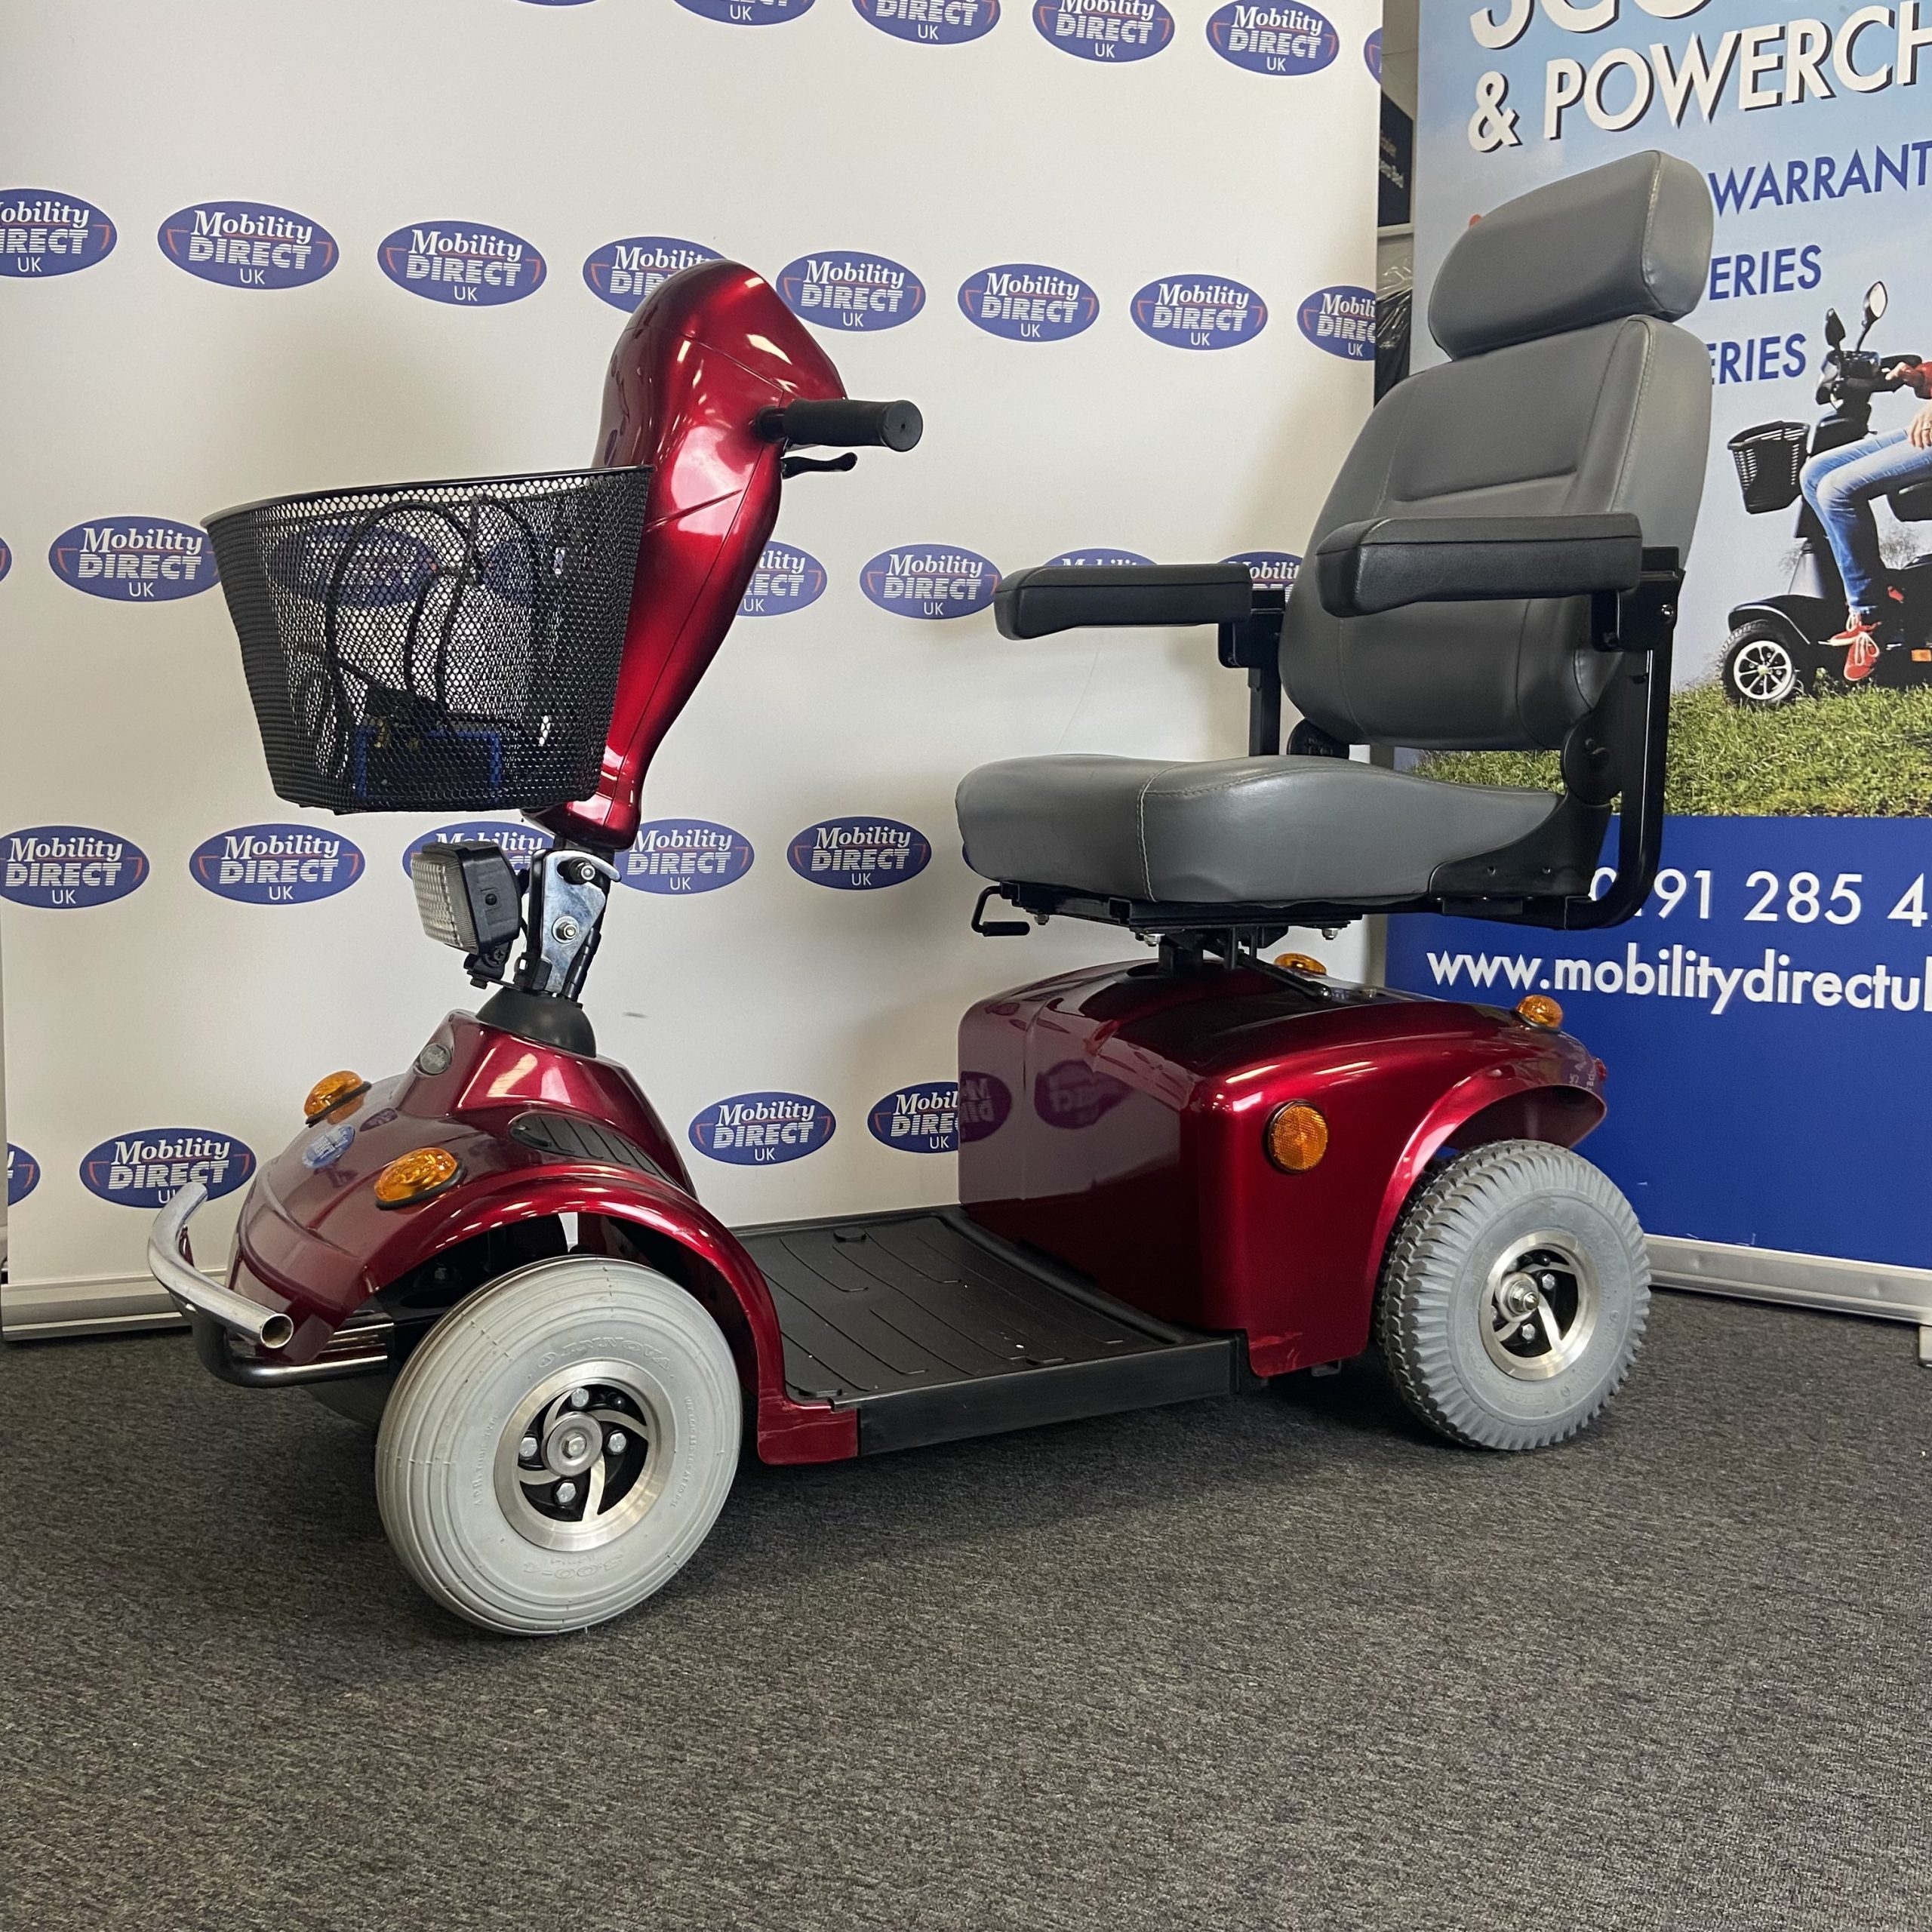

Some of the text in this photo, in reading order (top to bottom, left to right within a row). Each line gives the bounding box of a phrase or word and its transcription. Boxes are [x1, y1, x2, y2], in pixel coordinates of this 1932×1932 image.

[730, 5, 752, 21] UK
[876, 0, 978, 26] DIRECT
[1231, 5, 1322, 36] Mobility
[918, 25, 939, 39] UK
[1056, 14, 1152, 45] DIRECT
[1095, 43, 1115, 58] UK
[1229, 29, 1321, 58] DIRECT
[1266, 57, 1285, 72] UK
[1468, 71, 1521, 152] &
[0, 201, 89, 228] obility
[192, 211, 312, 243] Mobility
[189, 237, 312, 269] DIRECT
[411, 229, 521, 261] Mobility
[17, 256, 42, 272] UK
[612, 246, 714, 270] Mobilit
[240, 268, 265, 285] UK
[407, 255, 521, 286] DIRECT
[805, 260, 904, 289] Mobility
[454, 286, 478, 301] UK
[801, 284, 903, 312] DIRECT
[986, 273, 1079, 300] Mobility
[1155, 283, 1248, 308] Mobility
[981, 297, 1078, 323] DIRECT
[1319, 293, 1375, 317] Mobili
[843, 312, 863, 327] UK
[1020, 323, 1040, 337] UK
[1152, 307, 1247, 331] DIRECT
[1316, 315, 1376, 343] DIREC
[1191, 332, 1210, 346] UK
[1348, 343, 1363, 356] UK
[80, 528, 202, 555] Mobility
[78, 554, 202, 580] DIRECT
[759, 550, 805, 574] ility
[887, 554, 983, 578] Mobility
[1228, 561, 1300, 580] obilit
[128, 582, 154, 597] UK
[884, 577, 981, 599] DIRECT
[743, 598, 764, 612] UK
[924, 602, 943, 615] UK
[10, 836, 123, 862] Mobility
[221, 835, 340, 860] Mobility
[632, 829, 732, 853] Mobility
[814, 826, 911, 848] Mobility
[627, 852, 731, 874] DIRECT
[811, 848, 909, 870] DIRECT
[5, 862, 122, 887] DIRECT
[220, 859, 338, 884] DIRECT
[851, 872, 871, 886] UK
[269, 885, 294, 900] UK
[670, 877, 691, 891] UK
[51, 889, 75, 904] UK
[1744, 871, 1863, 924] 285
[1887, 872, 1932, 928] 4
[716, 1100, 814, 1126] Mobility
[894, 1091, 958, 1115] Mobil
[713, 1121, 814, 1149] DIRECT
[891, 1113, 958, 1137] DIRE
[111, 1137, 230, 1164] Mobility
[755, 1147, 775, 1161] UK
[929, 1136, 949, 1149] UK
[108, 1160, 229, 1189] DIRECT
